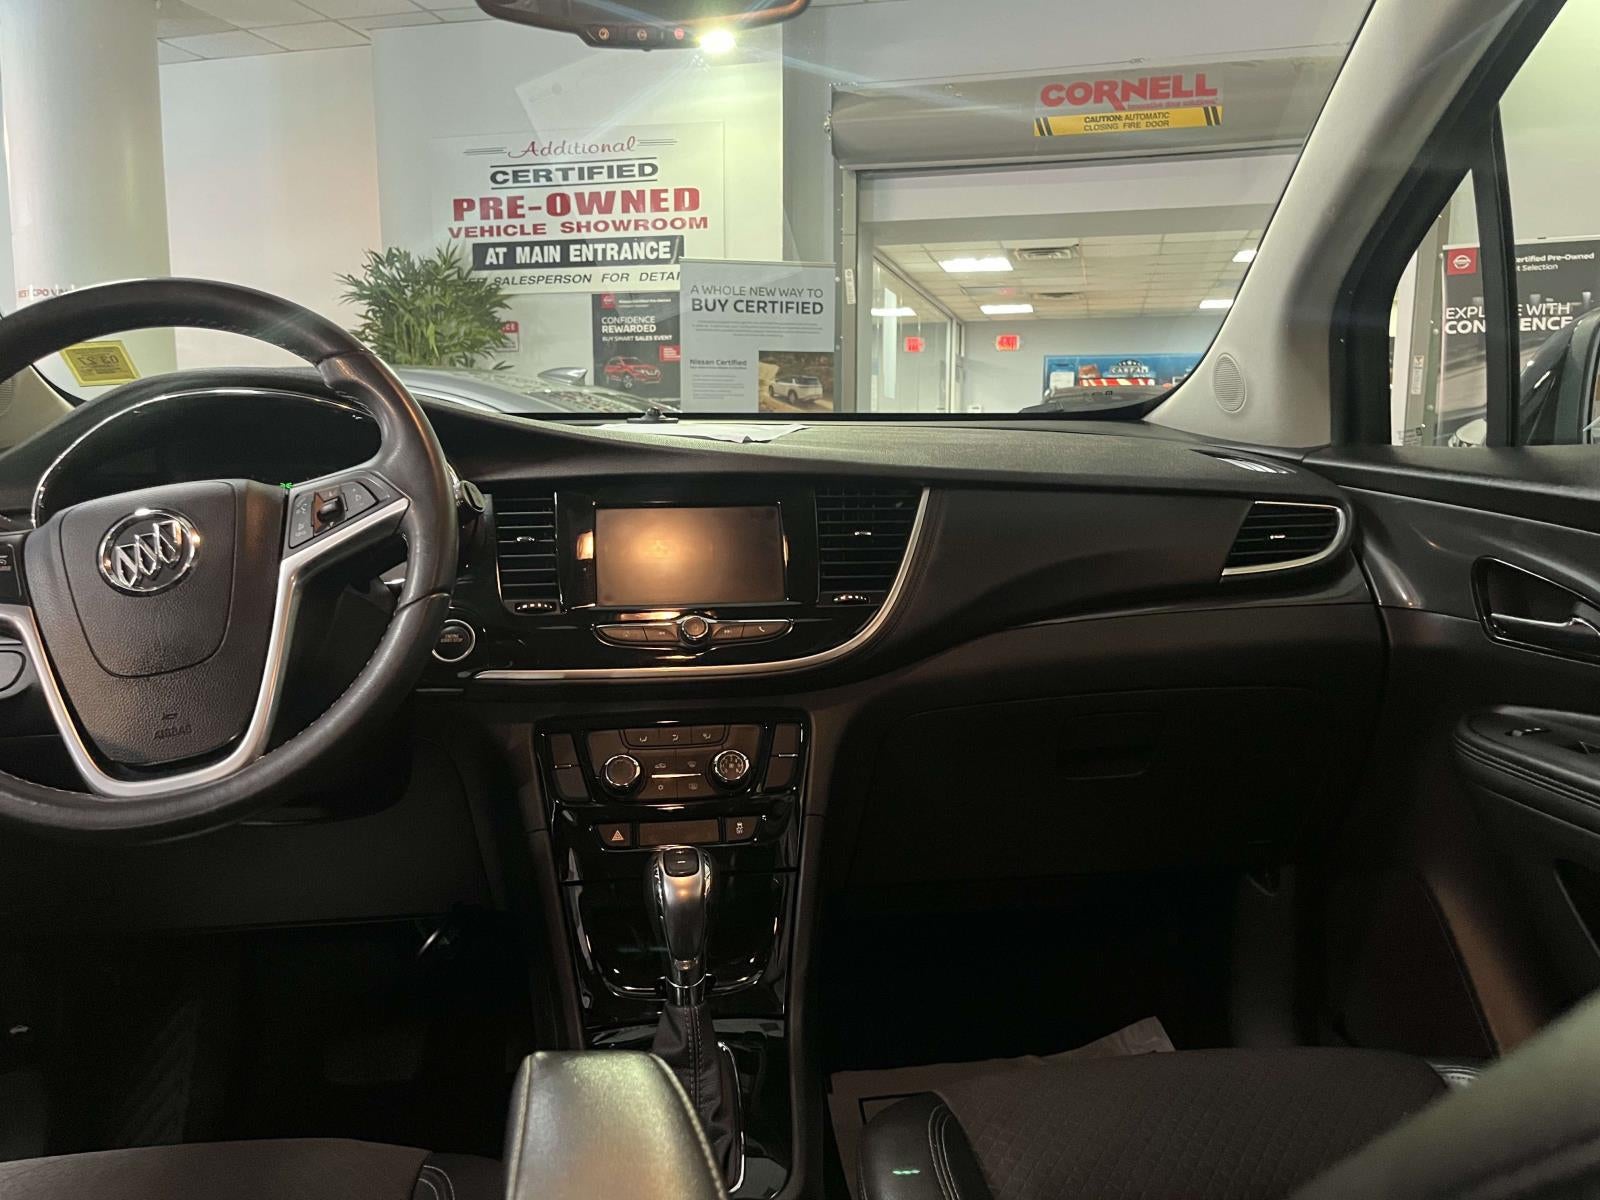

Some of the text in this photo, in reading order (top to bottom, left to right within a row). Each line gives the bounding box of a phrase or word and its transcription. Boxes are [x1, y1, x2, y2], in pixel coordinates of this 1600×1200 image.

[1040, 73, 1218, 112] CORNELL
[1125, 112, 1170, 121] AUTOMATIC
[1083, 120, 1170, 132] CLOSING FIRE DOOR
[508, 136, 636, 158] Additional
[490, 163, 659, 185] CERTIFIED
[453, 187, 700, 221] PRE-OWNED
[448, 216, 709, 239] VEHICLE SHOWROOM
[485, 240, 671, 265] AT MAIN ENTRANCE
[1515, 252, 1595, 263] ertified Pre-Owned
[1522, 263, 1558, 271] Selection
[494, 273, 592, 285] SALESPERSON
[601, 272, 630, 283] FOR
[639, 270, 680, 282] DETAI
[690, 285, 824, 298] A WHOLE NEW WAY TO
[691, 298, 824, 315] BUY CERTIFIED
[1526, 302, 1571, 316] WITH
[601, 316, 656, 324] CONFIDENCE
[601, 324, 657, 334] REWARDED
